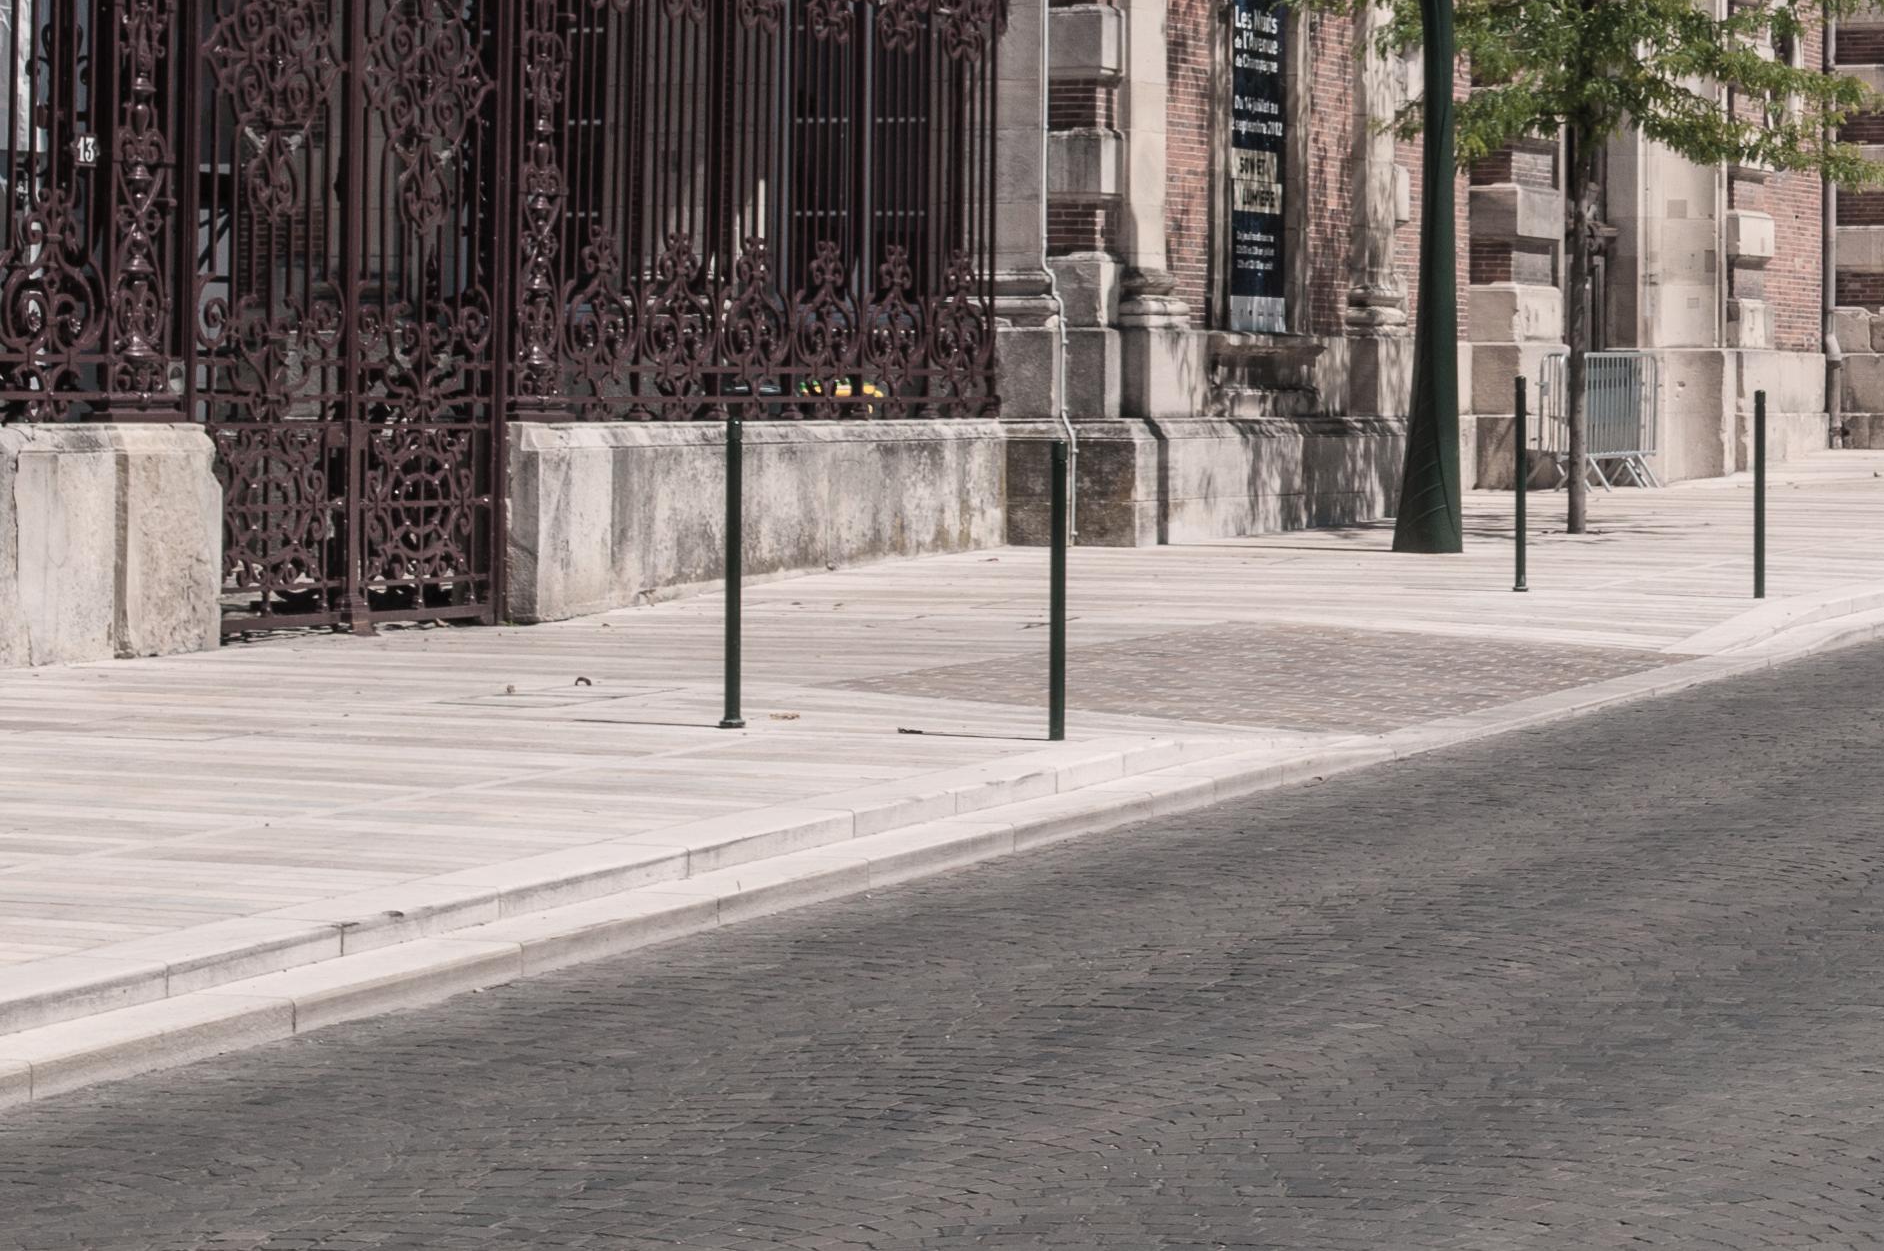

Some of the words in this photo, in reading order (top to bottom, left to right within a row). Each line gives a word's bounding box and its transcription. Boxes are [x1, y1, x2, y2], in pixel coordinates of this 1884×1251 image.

[1235, 5, 1252, 29] Les
[1254, 9, 1278, 34] Nuits
[1235, 35, 1242, 49] de
[1235, 54, 1242, 68] de
[1235, 95, 1243, 109] Du
[1271, 102, 1278, 115] au
[77, 136, 95, 162] 13
[1240, 157, 1255, 174] SON
[1256, 159, 1266, 176] ET
